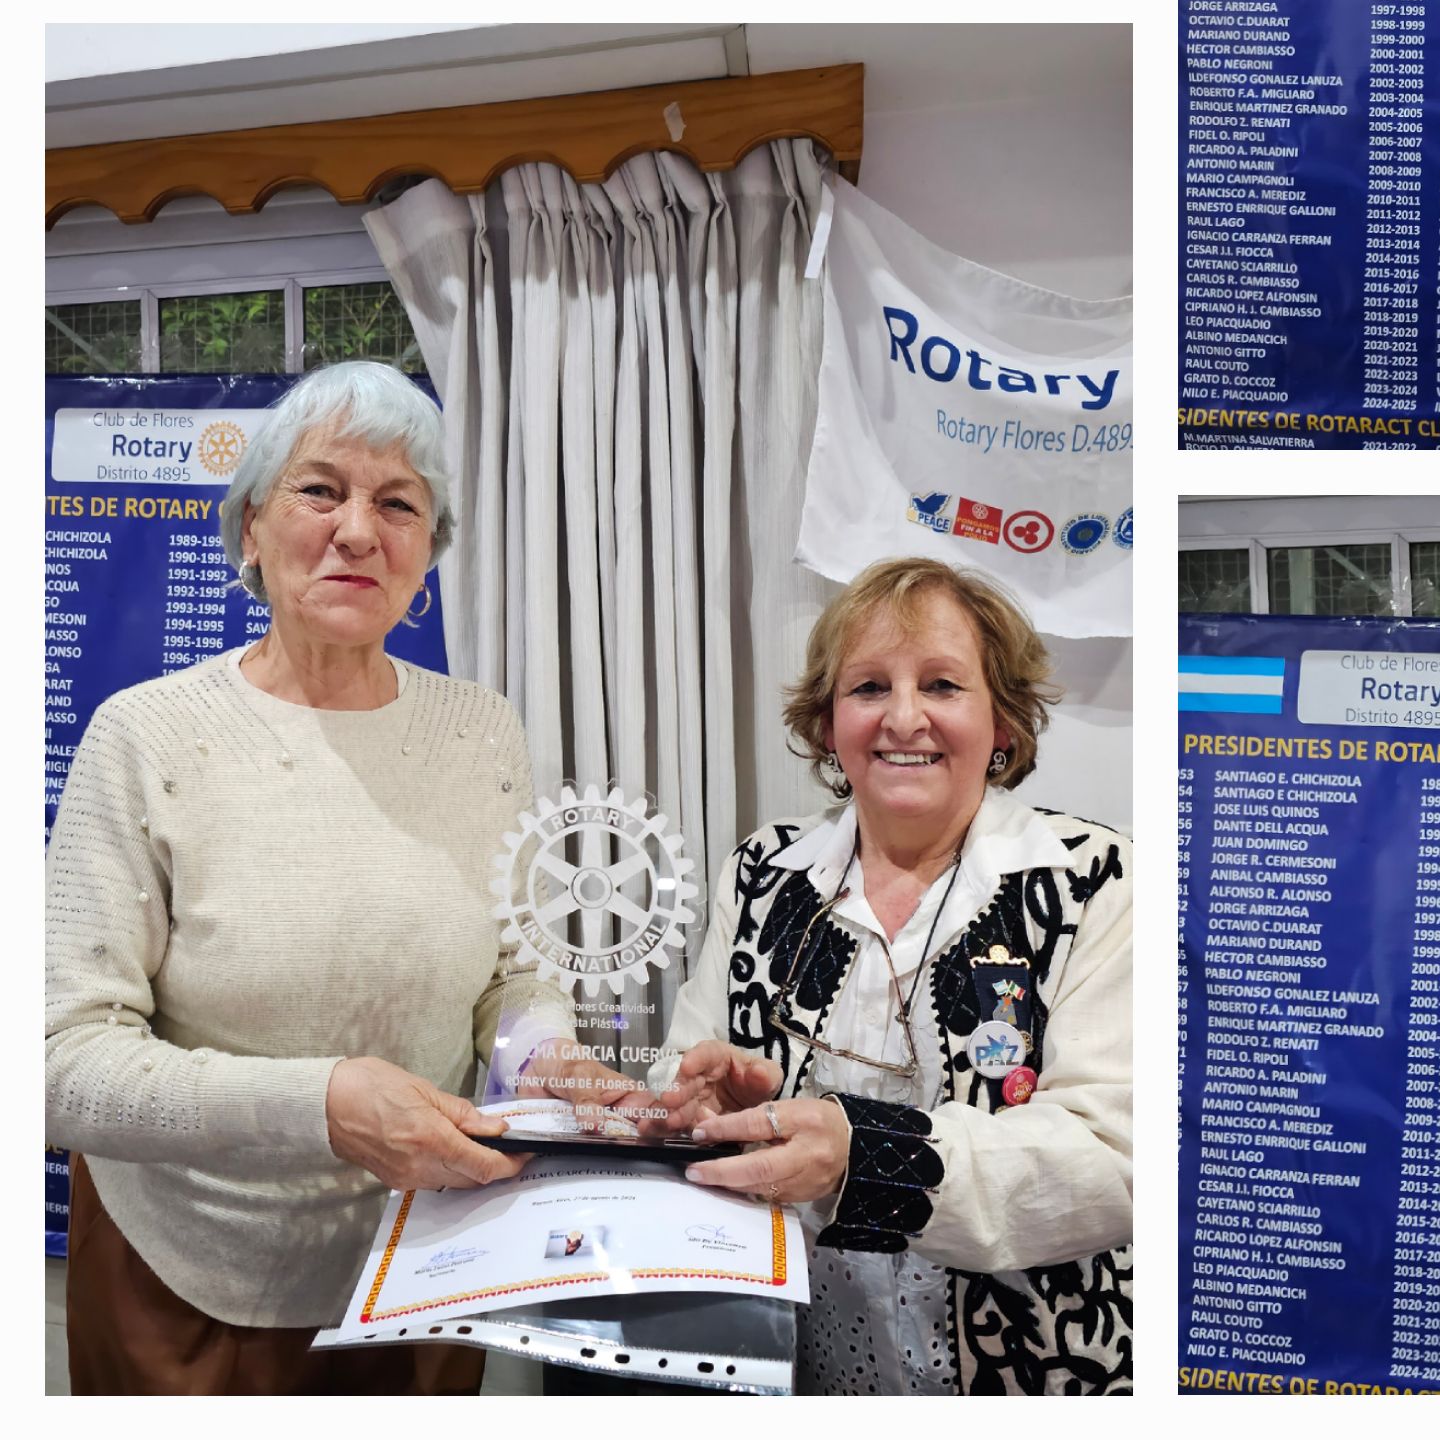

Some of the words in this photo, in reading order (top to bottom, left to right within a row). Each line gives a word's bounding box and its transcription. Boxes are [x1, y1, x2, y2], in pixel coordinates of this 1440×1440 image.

[1369, 121, 1423, 133] 2005-2006
[1369, 180, 1422, 192] 2009-2010
[883, 306, 1120, 410] Rotary
[1365, 369, 1417, 381] 2022-2023
[93, 412, 126, 429] Club
[130, 413, 149, 428] de
[152, 414, 194, 429] Flores
[1306, 414, 1413, 436] ROTARACT
[936, 409, 998, 454] Rotary
[1002, 420, 1065, 452] Flores
[112, 434, 193, 462] Rotary
[97, 466, 149, 481] Distrito
[152, 467, 191, 482] 4895
[90, 498, 118, 518] DE
[124, 498, 212, 520] ROTARY
[918, 514, 949, 530] PEACE
[1341, 655, 1376, 672] Club
[1380, 656, 1399, 672] de
[1345, 708, 1399, 725] Distrito
[1184, 734, 1332, 760] PRESIDENTES
[1339, 740, 1368, 761] DE
[550, 809, 635, 831] ROTARY
[520, 918, 668, 973] INTERNATIONAL
[599, 1003, 655, 1014] Creatividad
[590, 1018, 629, 1030] Plástica
[561, 1045, 616, 1062] GARCIA
[550, 1078, 575, 1087] CLUB
[578, 1079, 592, 1088] DE
[595, 1079, 634, 1090] FLORES
